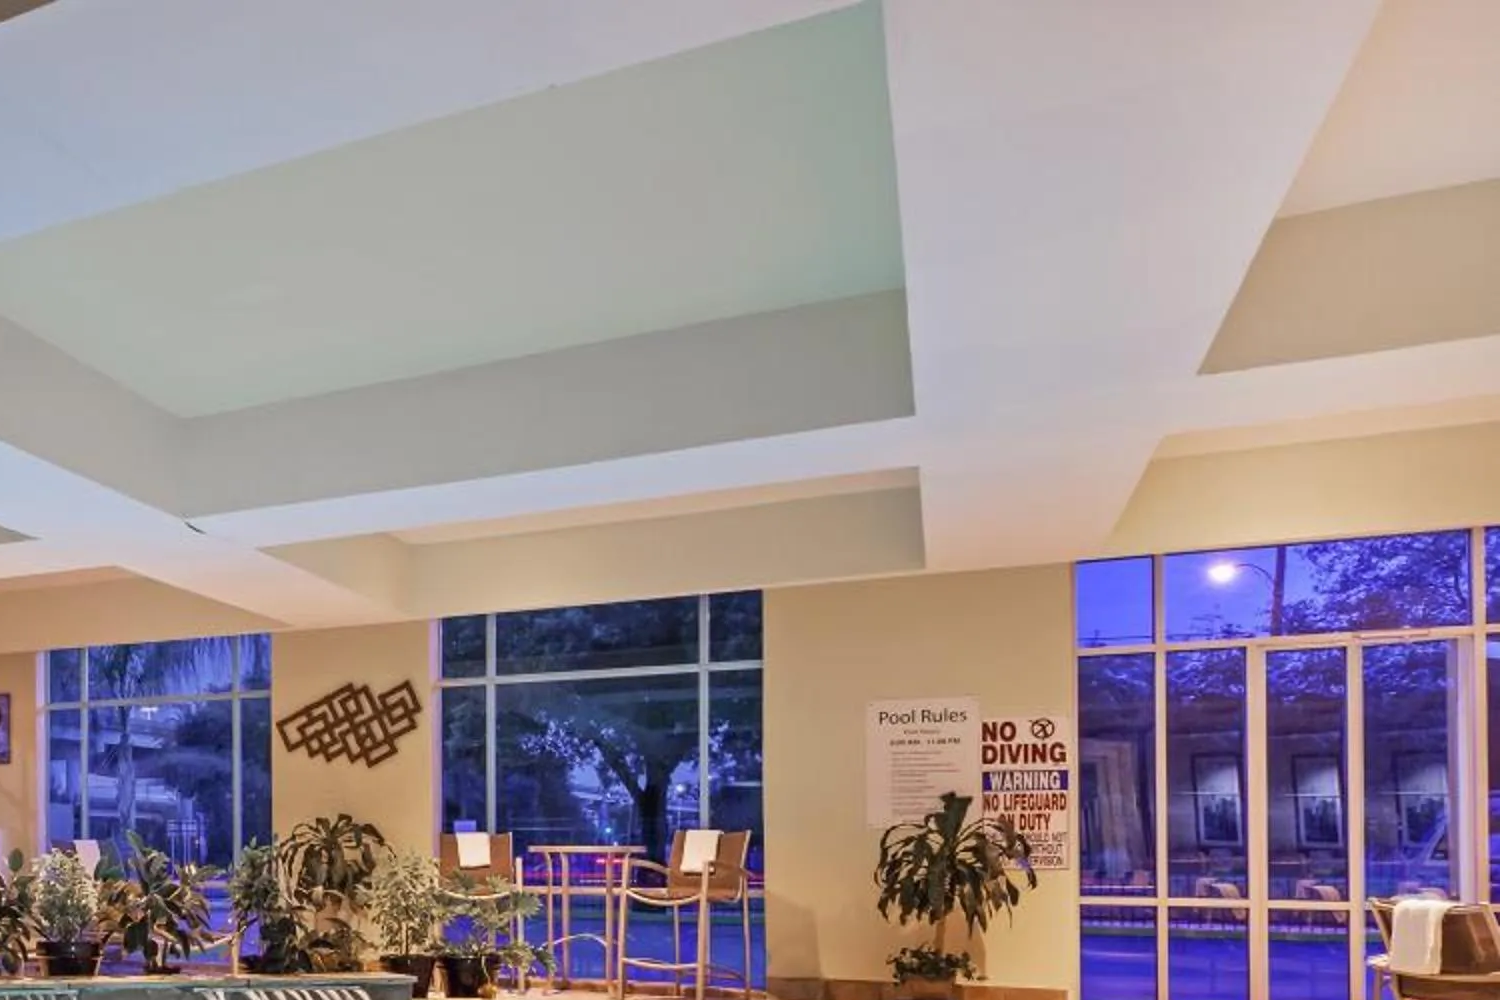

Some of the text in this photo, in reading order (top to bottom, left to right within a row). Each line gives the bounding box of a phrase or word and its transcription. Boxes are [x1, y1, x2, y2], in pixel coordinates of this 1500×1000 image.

[879, 708, 967, 725] Pool Rules
[982, 721, 1016, 742] NO
[982, 742, 1067, 764] DIVING
[991, 770, 1060, 792] WARNING
[983, 792, 1067, 811] NO LIFEGUARD
[1019, 813, 1051, 831] DUTY
